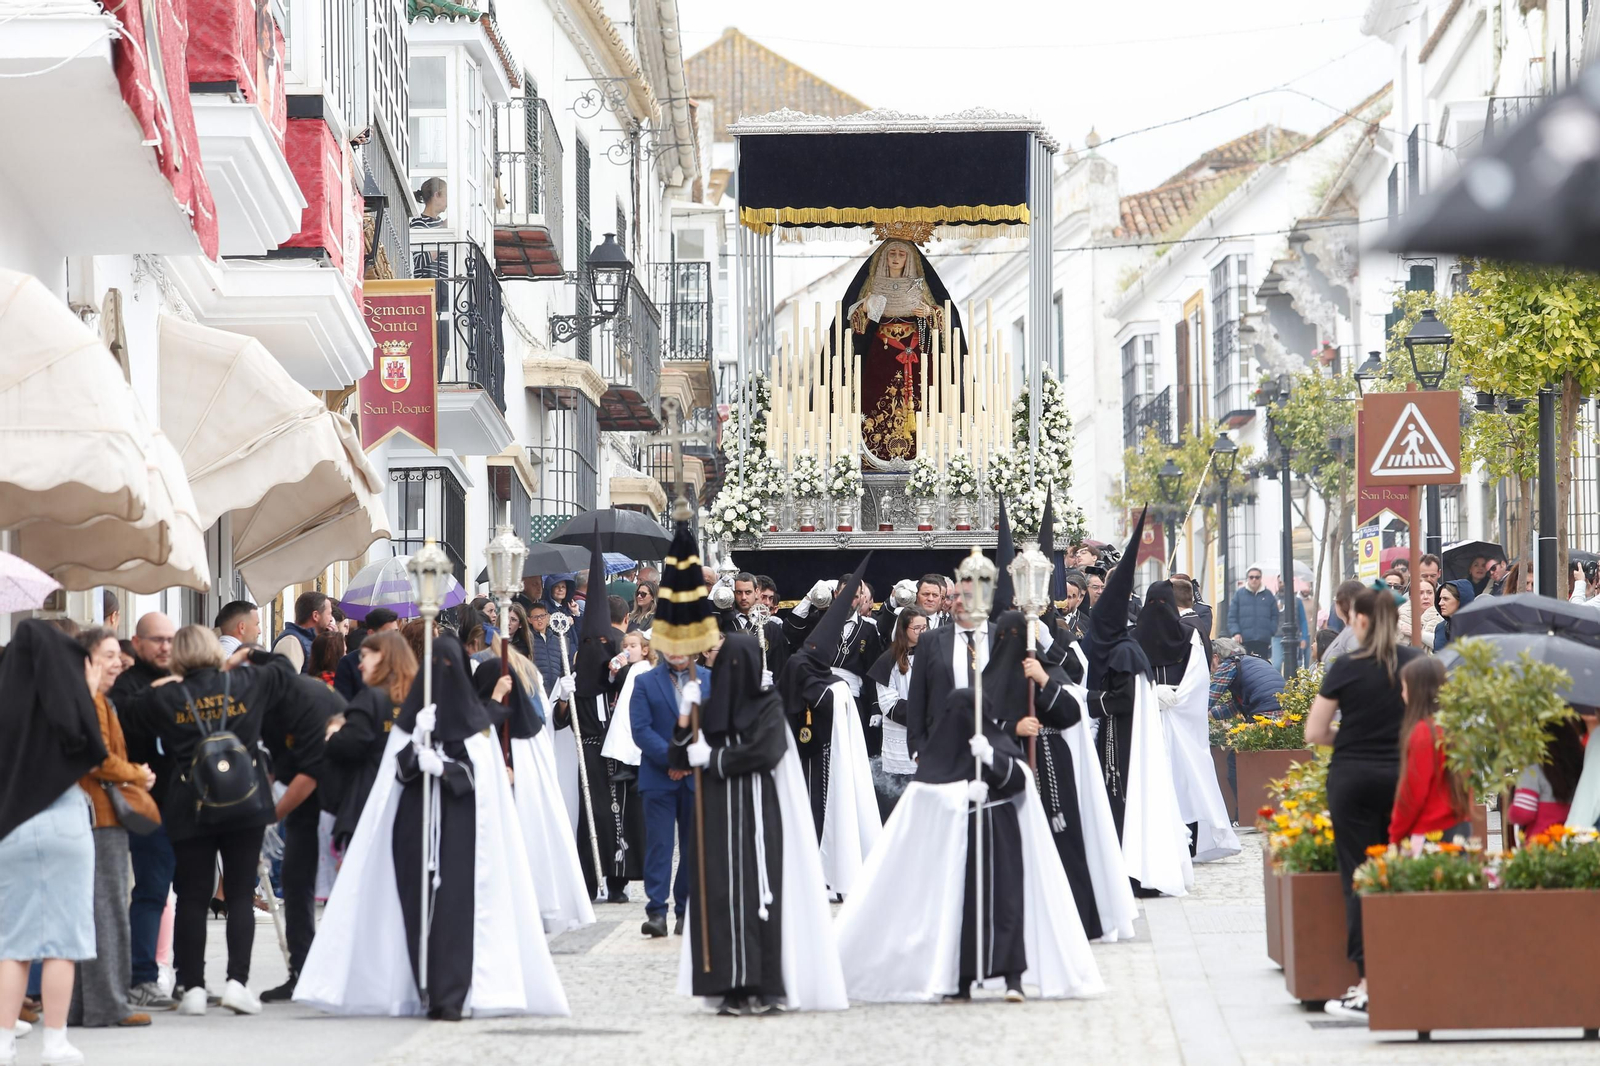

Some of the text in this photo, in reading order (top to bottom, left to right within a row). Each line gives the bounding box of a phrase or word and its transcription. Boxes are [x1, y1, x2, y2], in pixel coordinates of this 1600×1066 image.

[363, 299, 426, 316] Semana
[370, 315, 418, 333] Santa
[363, 400, 431, 415] San Roque
[1360, 489, 1380, 500] San
